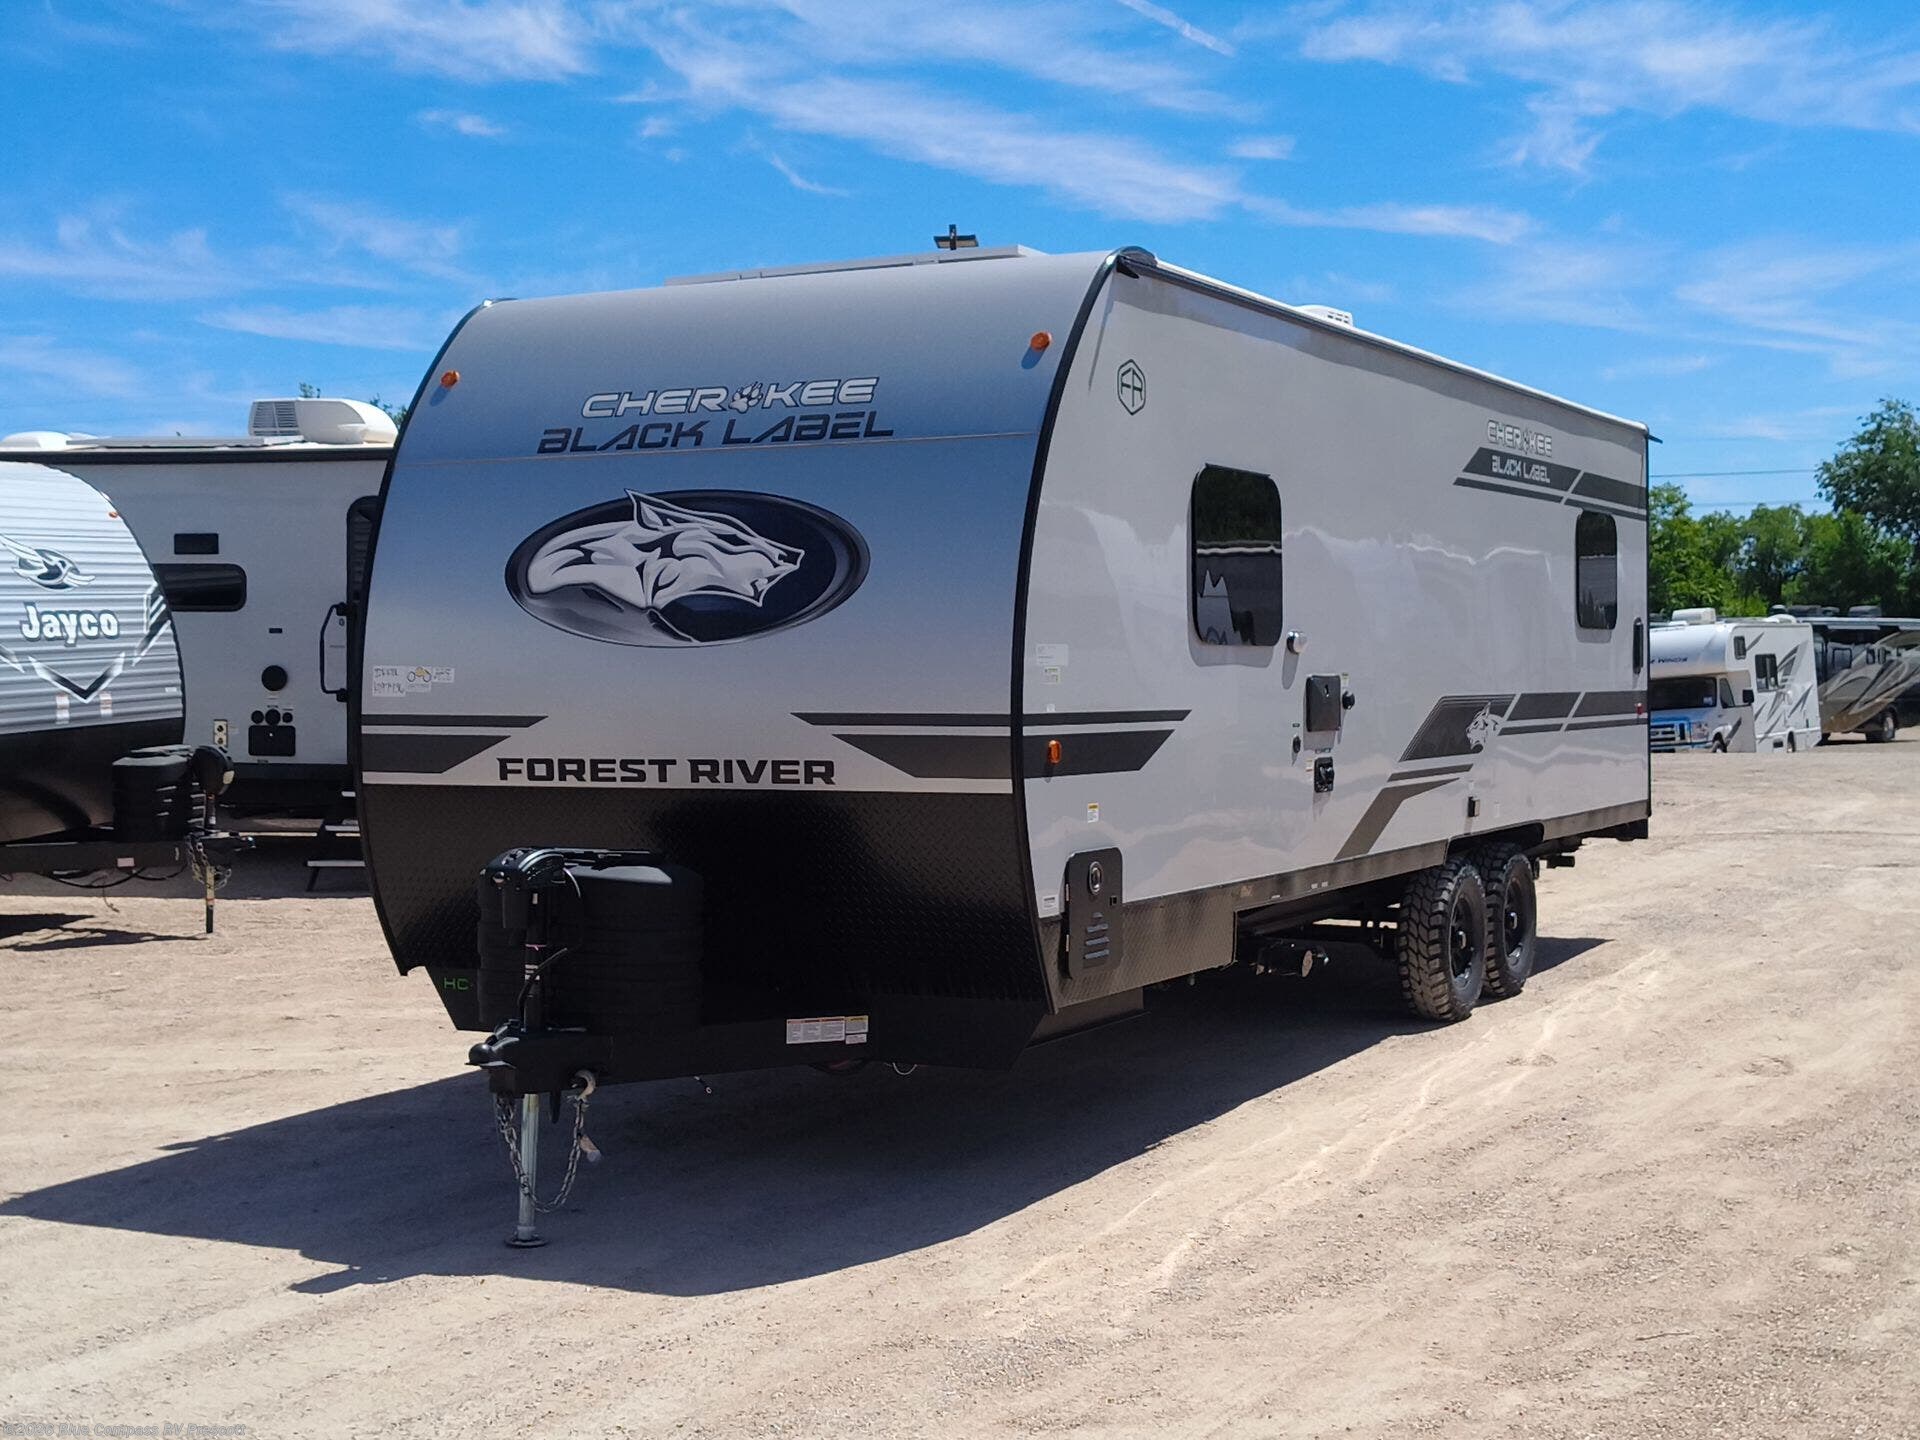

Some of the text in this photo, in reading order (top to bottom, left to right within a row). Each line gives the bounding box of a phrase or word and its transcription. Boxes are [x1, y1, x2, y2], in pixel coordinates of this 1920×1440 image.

[581, 376, 880, 418] CHEROKEE
[537, 411, 894, 454] BLACK LABEL
[1487, 419, 1552, 458] CHEROKEE
[1491, 455, 1551, 484] BLACK LABEL
[20, 601, 120, 646] Jayco
[496, 758, 836, 785] FOREST RIVER
